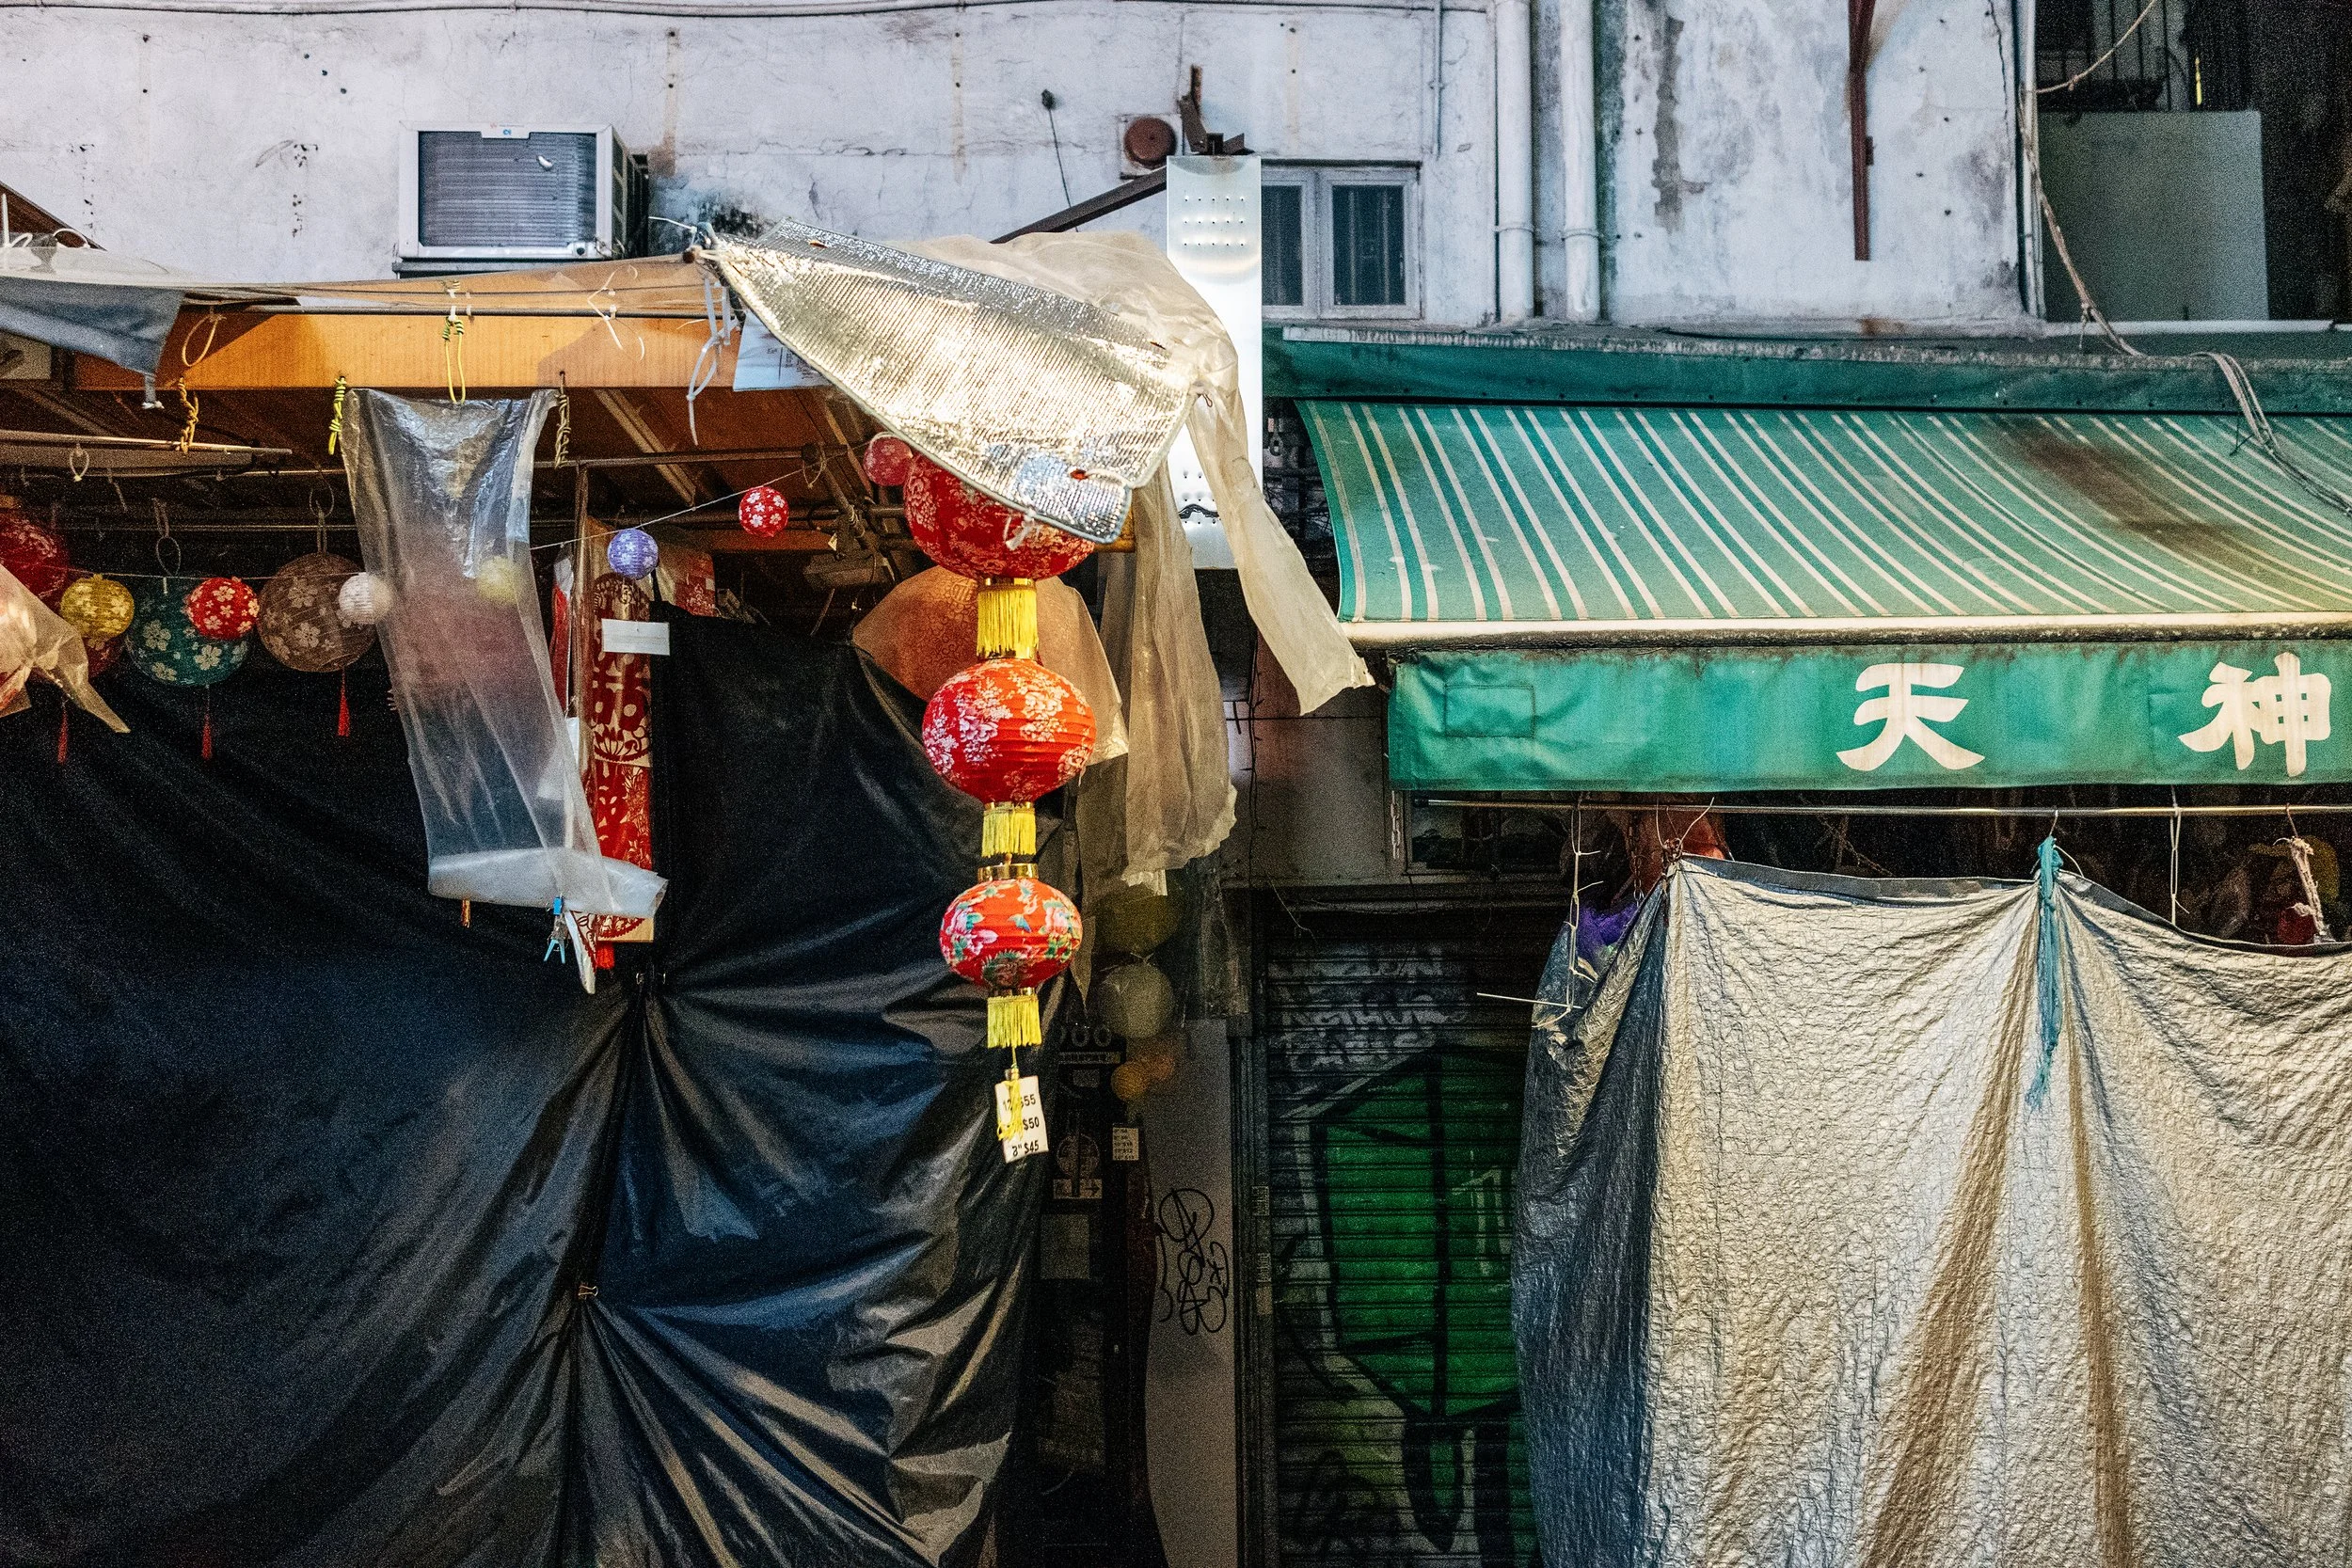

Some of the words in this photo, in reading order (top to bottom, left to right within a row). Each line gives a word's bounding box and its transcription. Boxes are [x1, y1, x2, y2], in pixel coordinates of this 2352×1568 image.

[1836, 651, 2332, 778] 天神
[1022, 1117, 1040, 1131] $50
[1024, 1139, 1040, 1154] $45
